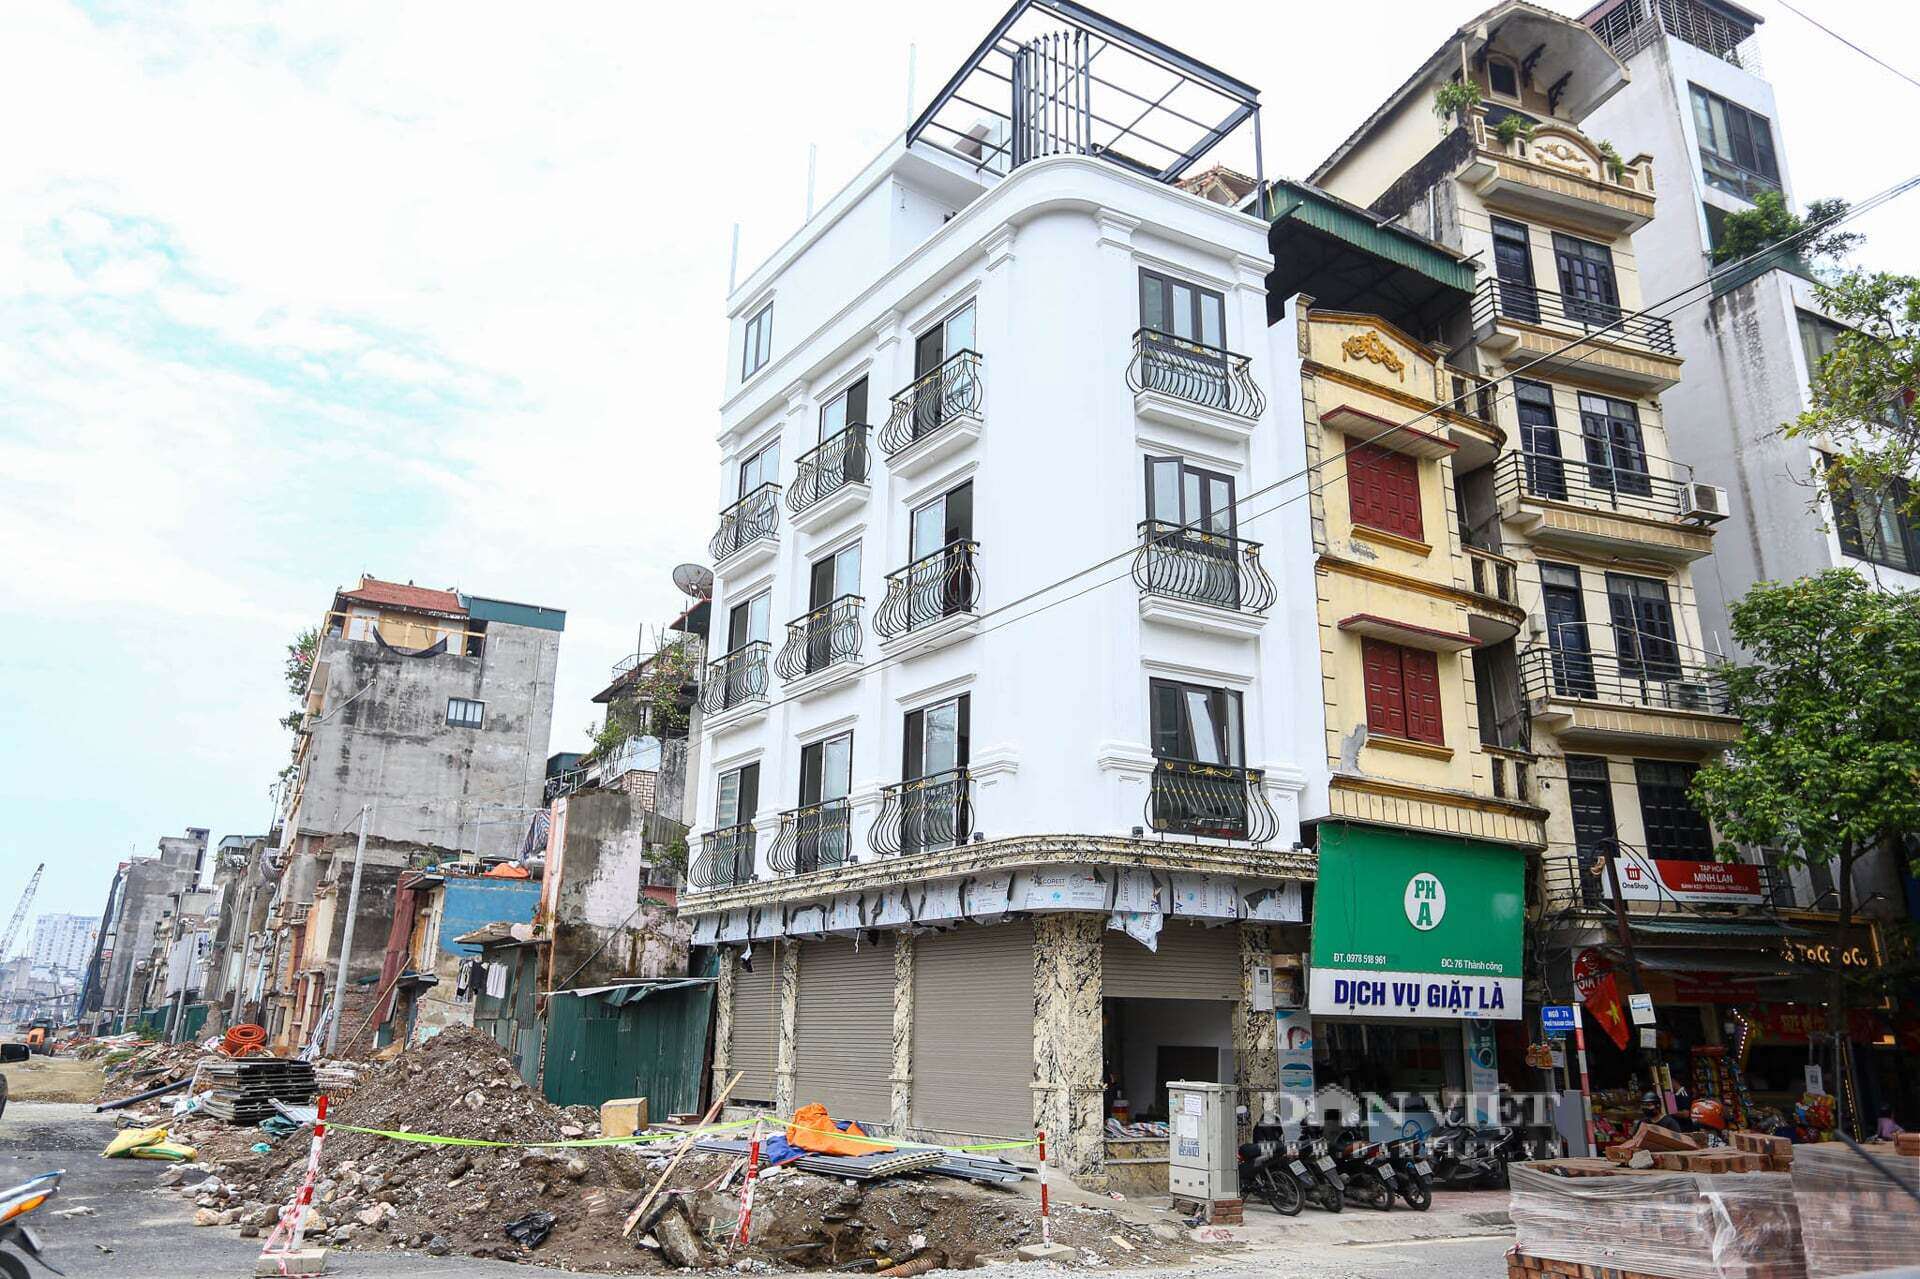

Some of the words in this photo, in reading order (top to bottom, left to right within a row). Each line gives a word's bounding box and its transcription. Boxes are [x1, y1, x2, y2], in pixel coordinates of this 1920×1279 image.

[1694, 873, 1716, 882] MINH
[1717, 873, 1733, 883] LAN
[1415, 880, 1436, 899] PH
[1622, 882, 1649, 891] OneShop
[1416, 902, 1433, 926] A
[1375, 955, 1386, 965] 961
[1454, 959, 1463, 968] 76
[1334, 979, 1386, 1010] DỊCH
[1392, 982, 1421, 1012] VỤ
[1427, 979, 1473, 1014] GIẶT
[1479, 981, 1504, 1010] LÀ
